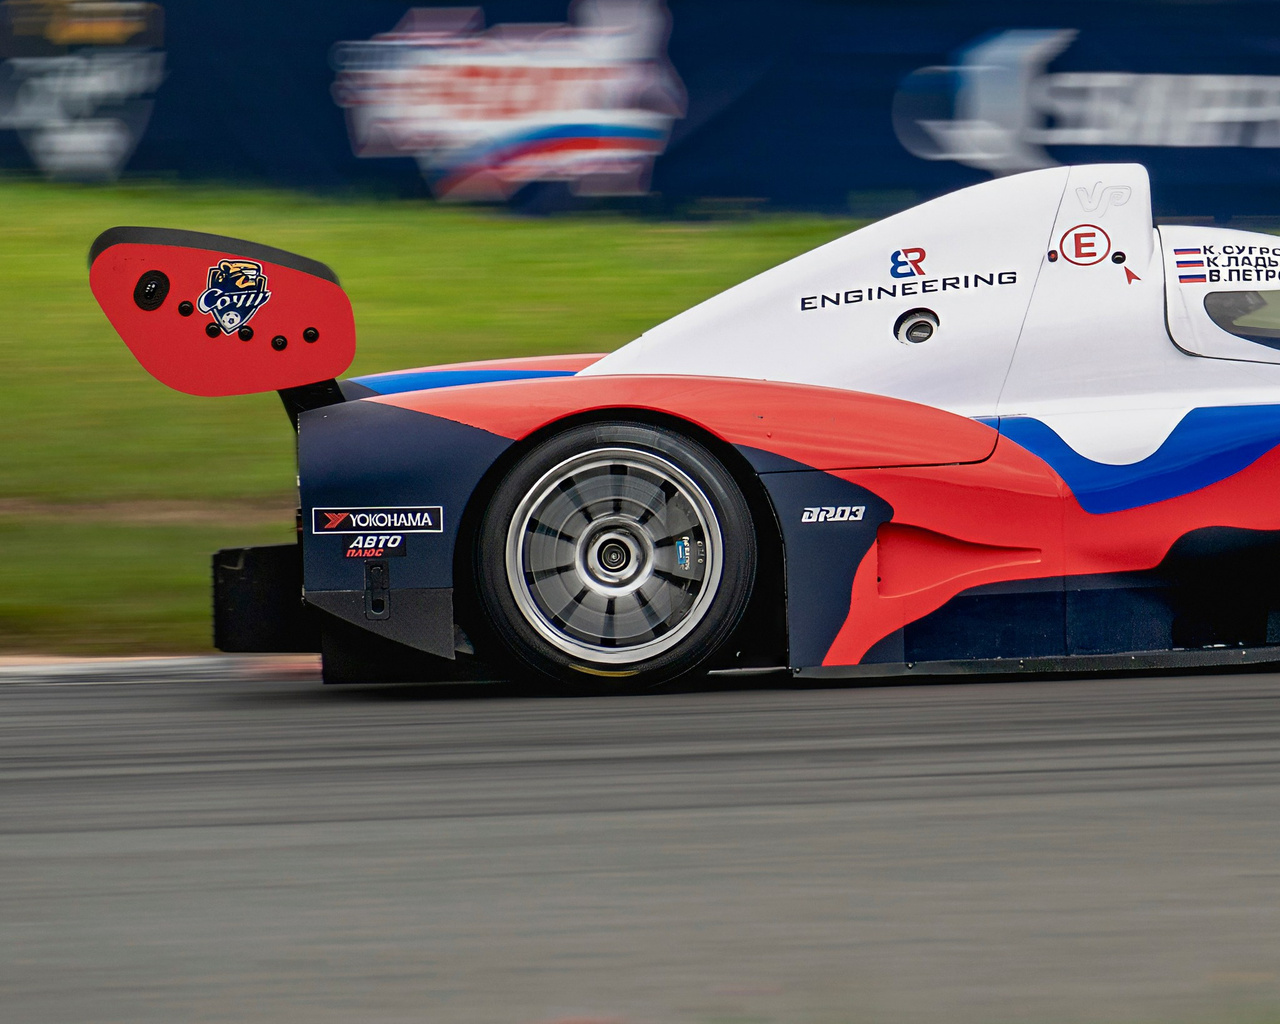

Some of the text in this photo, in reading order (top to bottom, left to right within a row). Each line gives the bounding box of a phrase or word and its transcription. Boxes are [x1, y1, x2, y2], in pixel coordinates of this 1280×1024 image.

[1074, 232, 1097, 258] E
[800, 271, 1017, 311] ENGINEERING
[350, 513, 432, 527] YOKOHAMA
[349, 536, 401, 549] АВТО
[346, 549, 384, 557] ПЛЮС
